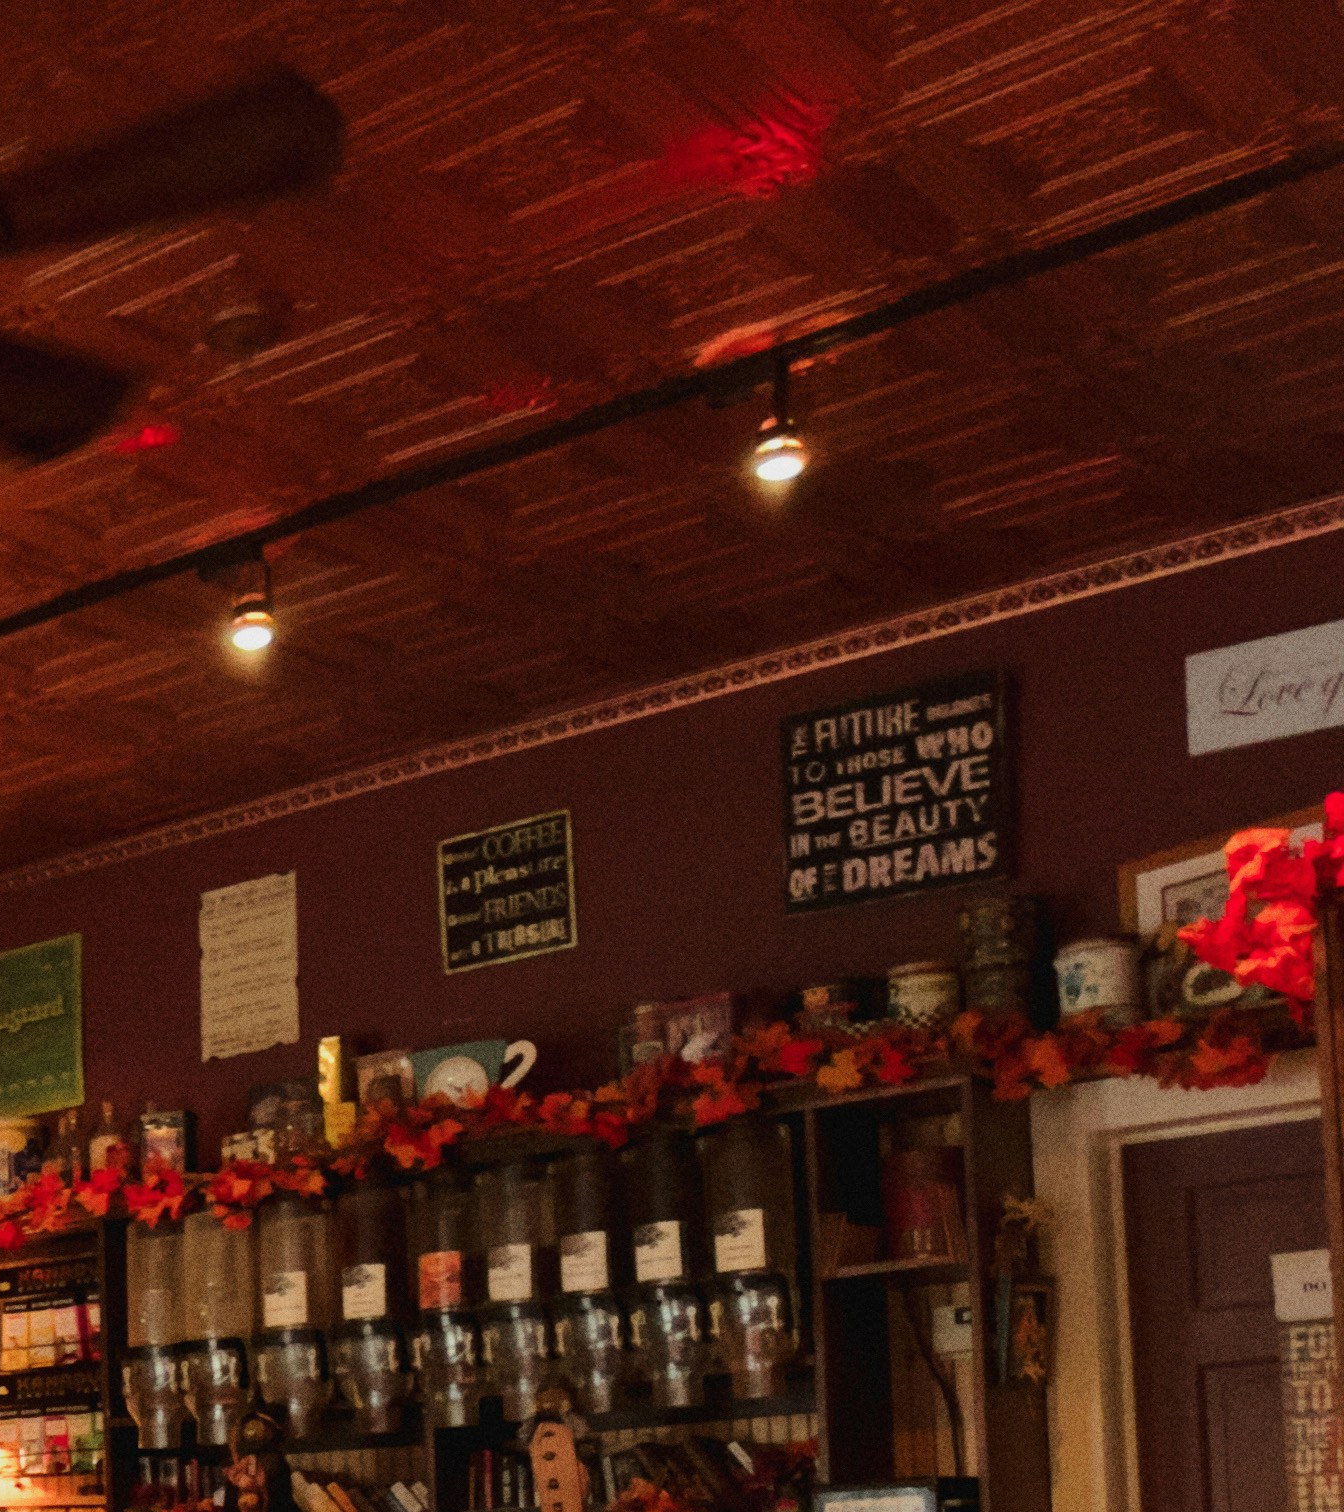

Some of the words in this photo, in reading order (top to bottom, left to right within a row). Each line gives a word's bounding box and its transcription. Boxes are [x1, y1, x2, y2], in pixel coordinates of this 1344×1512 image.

[1220, 664, 1312, 716] Love
[836, 745, 907, 776] THOSE
[914, 720, 994, 760] WHO
[791, 754, 991, 826] BELIEVE
[481, 820, 565, 861] COFFEE
[790, 832, 811, 859] IN
[848, 795, 989, 847] BEAUTY
[473, 854, 566, 895] pleasure
[788, 866, 817, 897] OF
[842, 831, 999, 893] DREAMS
[483, 882, 568, 923] FRIENDS
